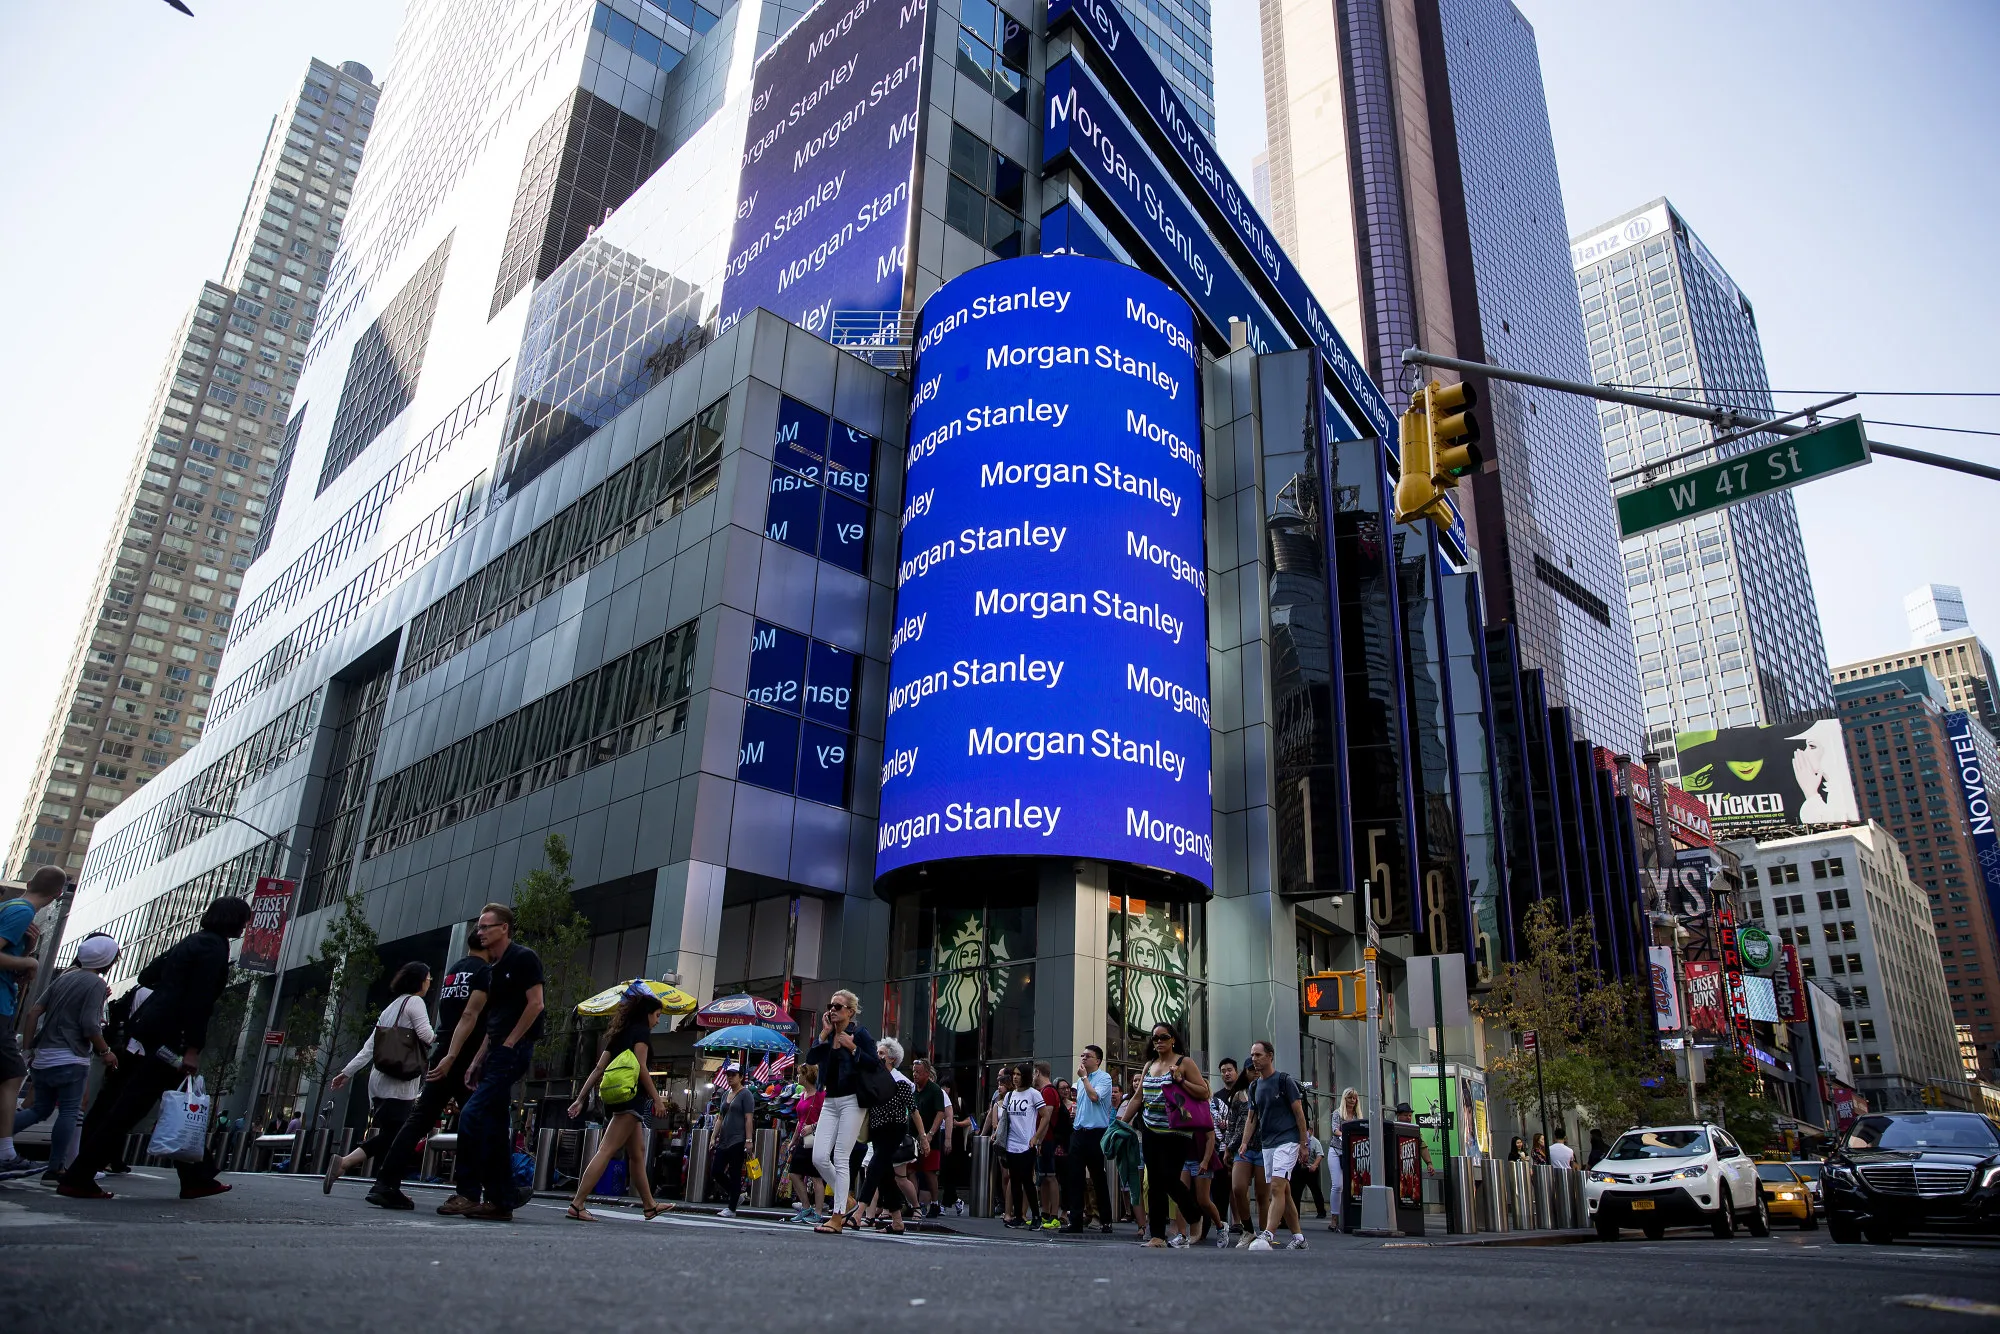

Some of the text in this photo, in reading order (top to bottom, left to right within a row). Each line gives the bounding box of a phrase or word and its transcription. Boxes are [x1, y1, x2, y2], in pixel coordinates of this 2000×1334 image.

[788, 53, 858, 126] Stanley
[793, 99, 865, 173] Morgan
[773, 170, 846, 241] Stanley
[1050, 86, 1141, 199] Morgan
[1144, 183, 1214, 297] Stanley
[1160, 86, 1281, 281] Morgan Stanley
[777, 222, 852, 294] Morgan
[914, 286, 1071, 361] Morgan Stanley
[1126, 298, 1193, 360] Morgan
[986, 345, 1179, 399] Morgan Stanley
[1306, 297, 1390, 438] Morgan Stanley
[906, 399, 1069, 473] Morgan Stanley
[1127, 409, 1196, 469] Morgan
[980, 461, 1182, 516] Morgan Stanley
[1669, 446, 1802, 511] W 47 St
[898, 520, 1067, 591] Morgan Stanley
[1127, 531, 1198, 588] Morgan
[975, 588, 1184, 644] Morgan Stanley
[888, 653, 1064, 718] Morgan Stanley
[1127, 663, 1201, 718] Morgan
[968, 727, 1185, 782] Morgan Stanley
[1950, 724, 1994, 835] NOVOTEL
[878, 798, 1061, 854] Morgan Stanley
[1126, 807, 1203, 856] Morgan
[251, 896, 290, 912] JERSEY
[252, 911, 280, 929] BOYS
[1688, 973, 1720, 993] JERSEY
[1693, 990, 1716, 1007] BOYS
[1352, 1140, 1371, 1158] JERS
[1356, 1156, 1371, 1172] BOY
